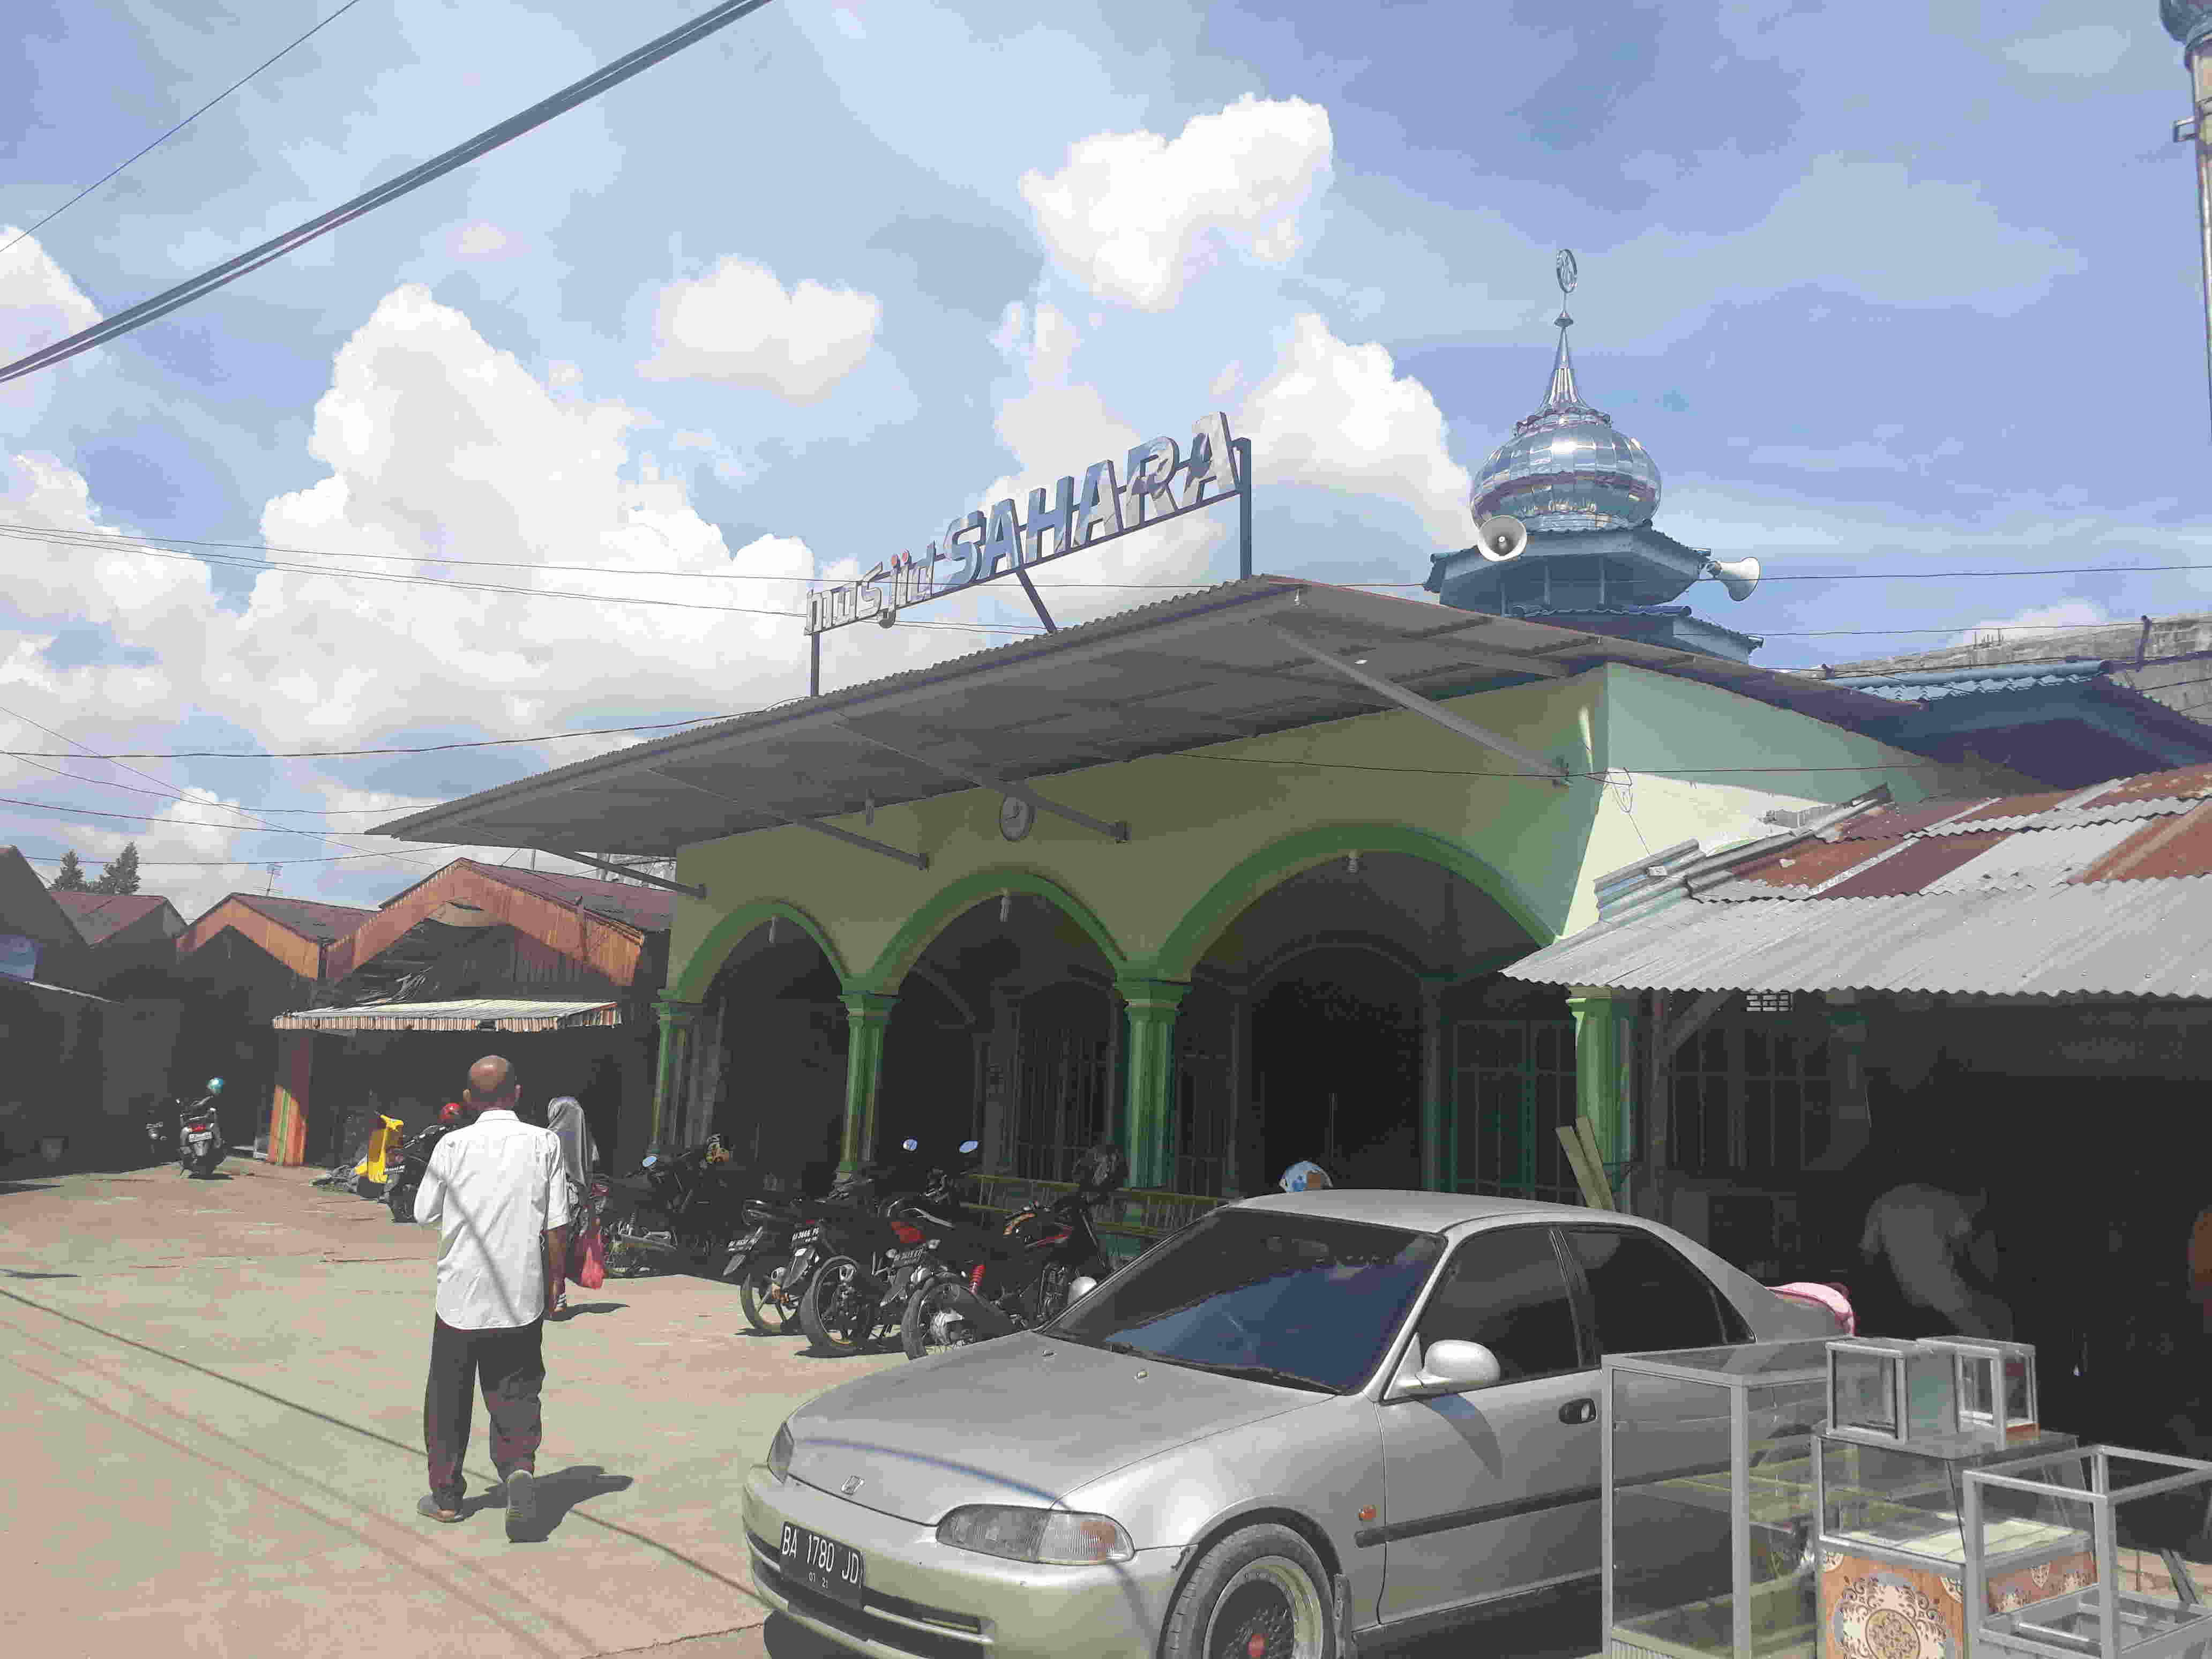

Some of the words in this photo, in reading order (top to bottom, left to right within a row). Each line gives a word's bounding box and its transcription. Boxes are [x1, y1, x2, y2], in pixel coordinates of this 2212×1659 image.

[938, 411, 1239, 591] SAHARA
[782, 1526, 798, 1558] BA
[806, 1534, 834, 1572] 1780
[842, 1551, 858, 1584] JD
